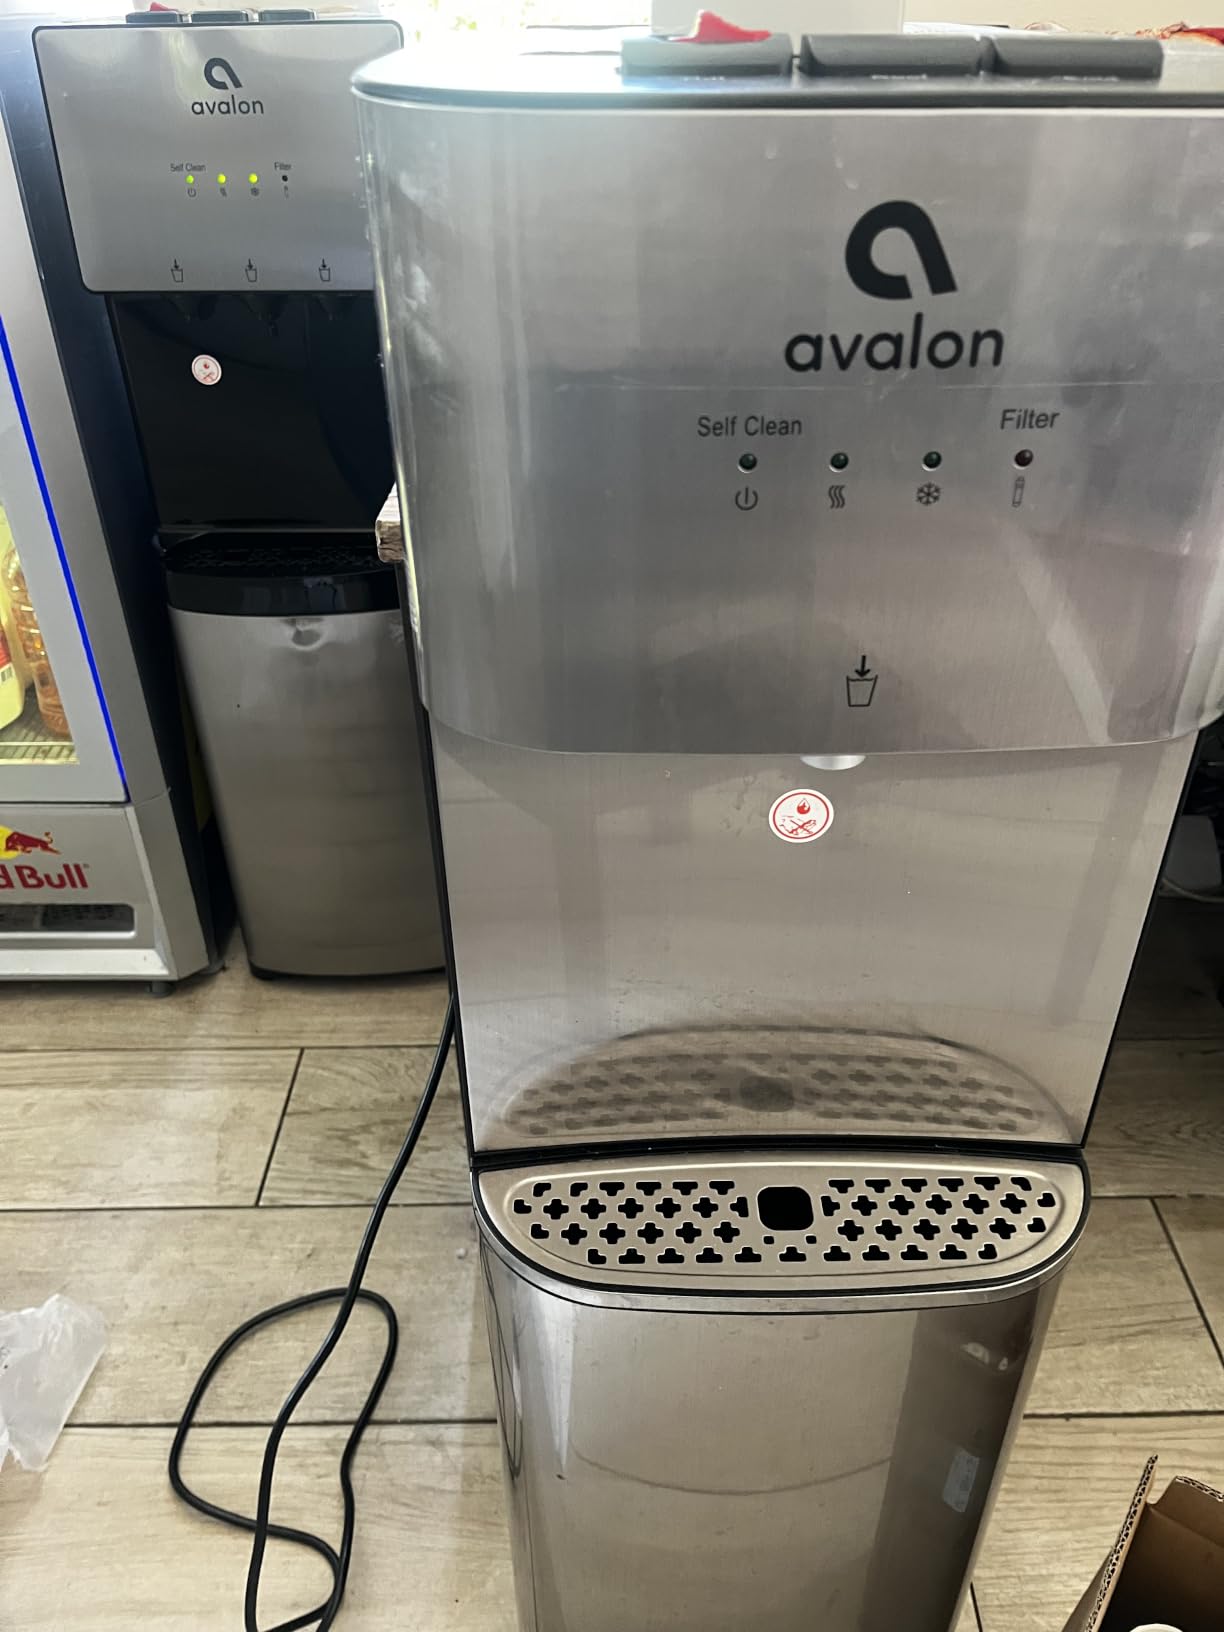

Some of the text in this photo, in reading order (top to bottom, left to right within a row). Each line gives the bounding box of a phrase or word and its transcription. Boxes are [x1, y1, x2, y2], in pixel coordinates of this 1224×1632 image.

[191, 94, 264, 115] avalon
[185, 162, 206, 171] Clean
[784, 311, 1004, 372] avalon
[697, 415, 803, 437] Self Clean
[1000, 408, 1060, 430] Filter
[14, 863, 88, 889] Bull
